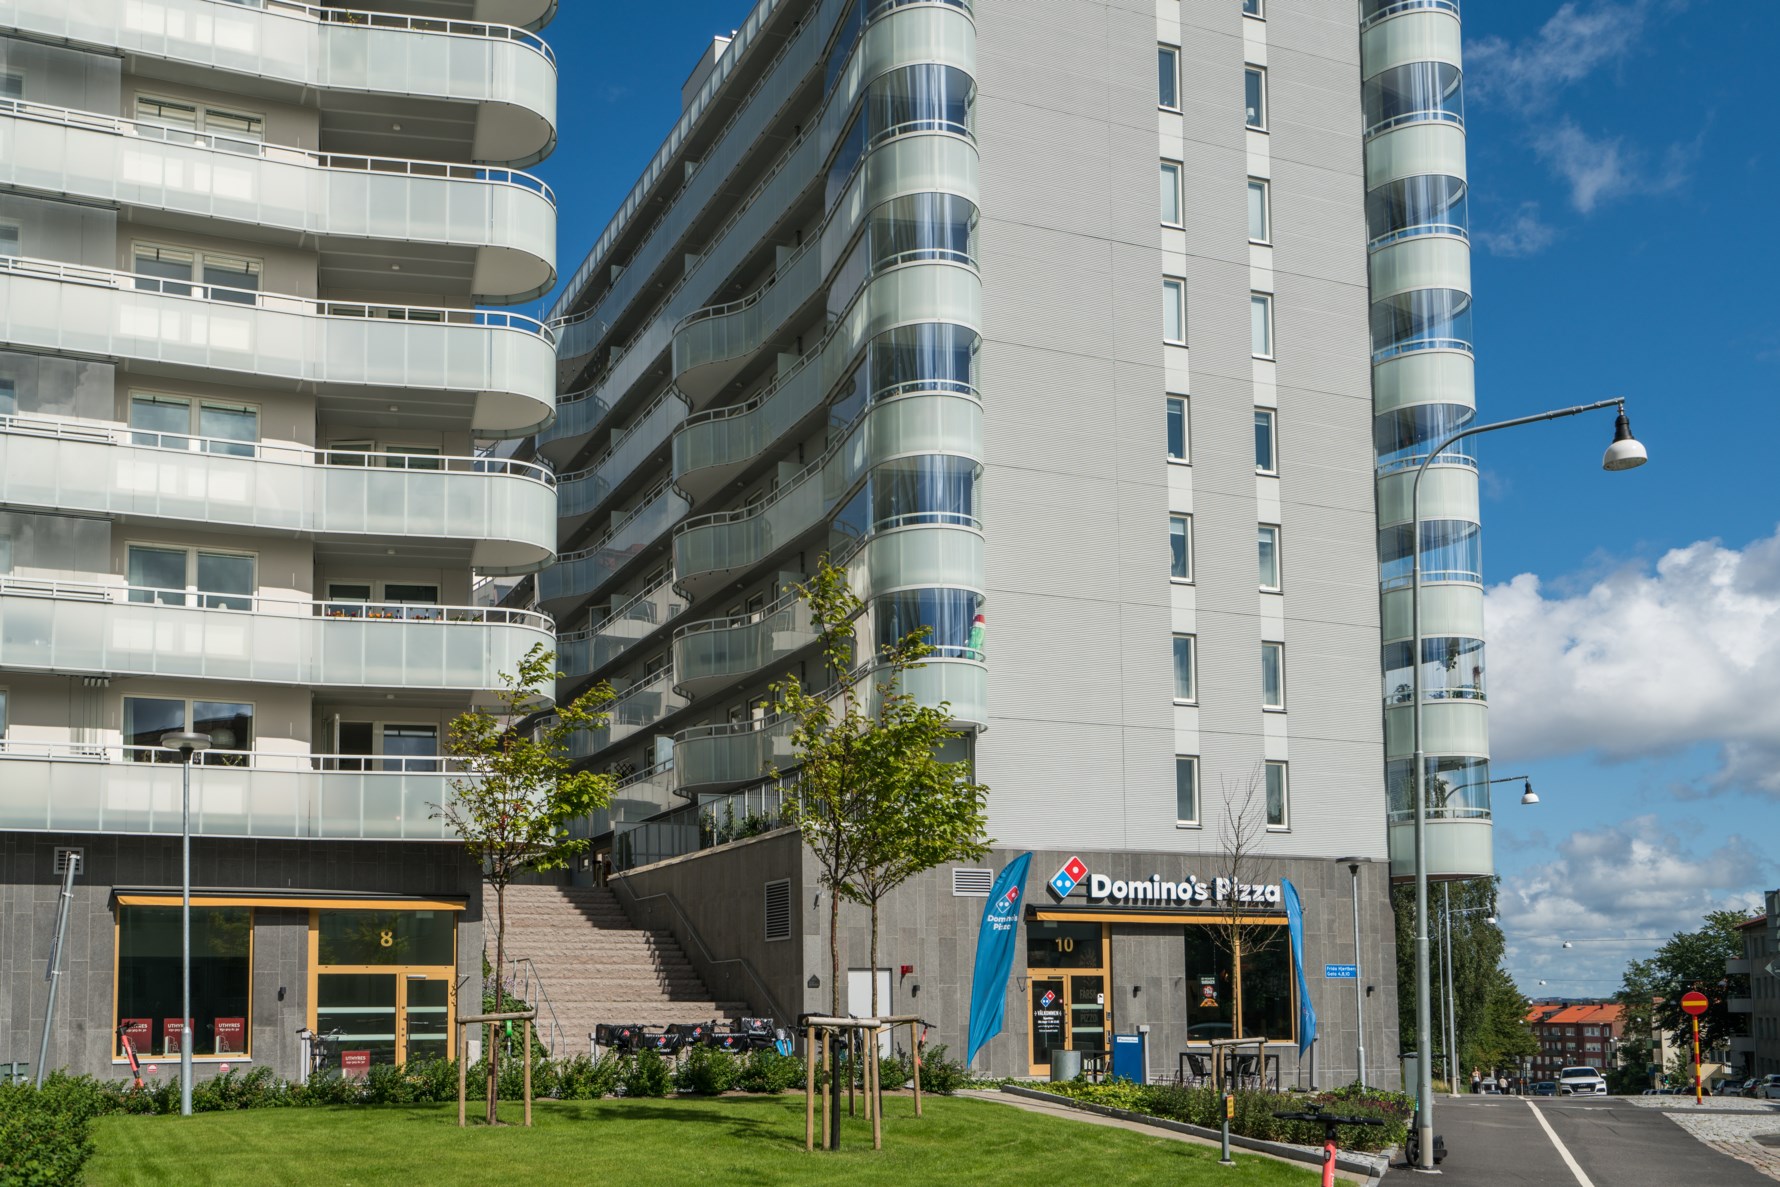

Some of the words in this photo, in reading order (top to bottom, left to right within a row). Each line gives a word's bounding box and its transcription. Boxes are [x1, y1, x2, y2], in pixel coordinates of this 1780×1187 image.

[1091, 874, 1208, 900] Domino's
[1216, 876, 1280, 902] Pizza
[380, 930, 393, 947] 8
[1055, 937, 1074, 952] 10
